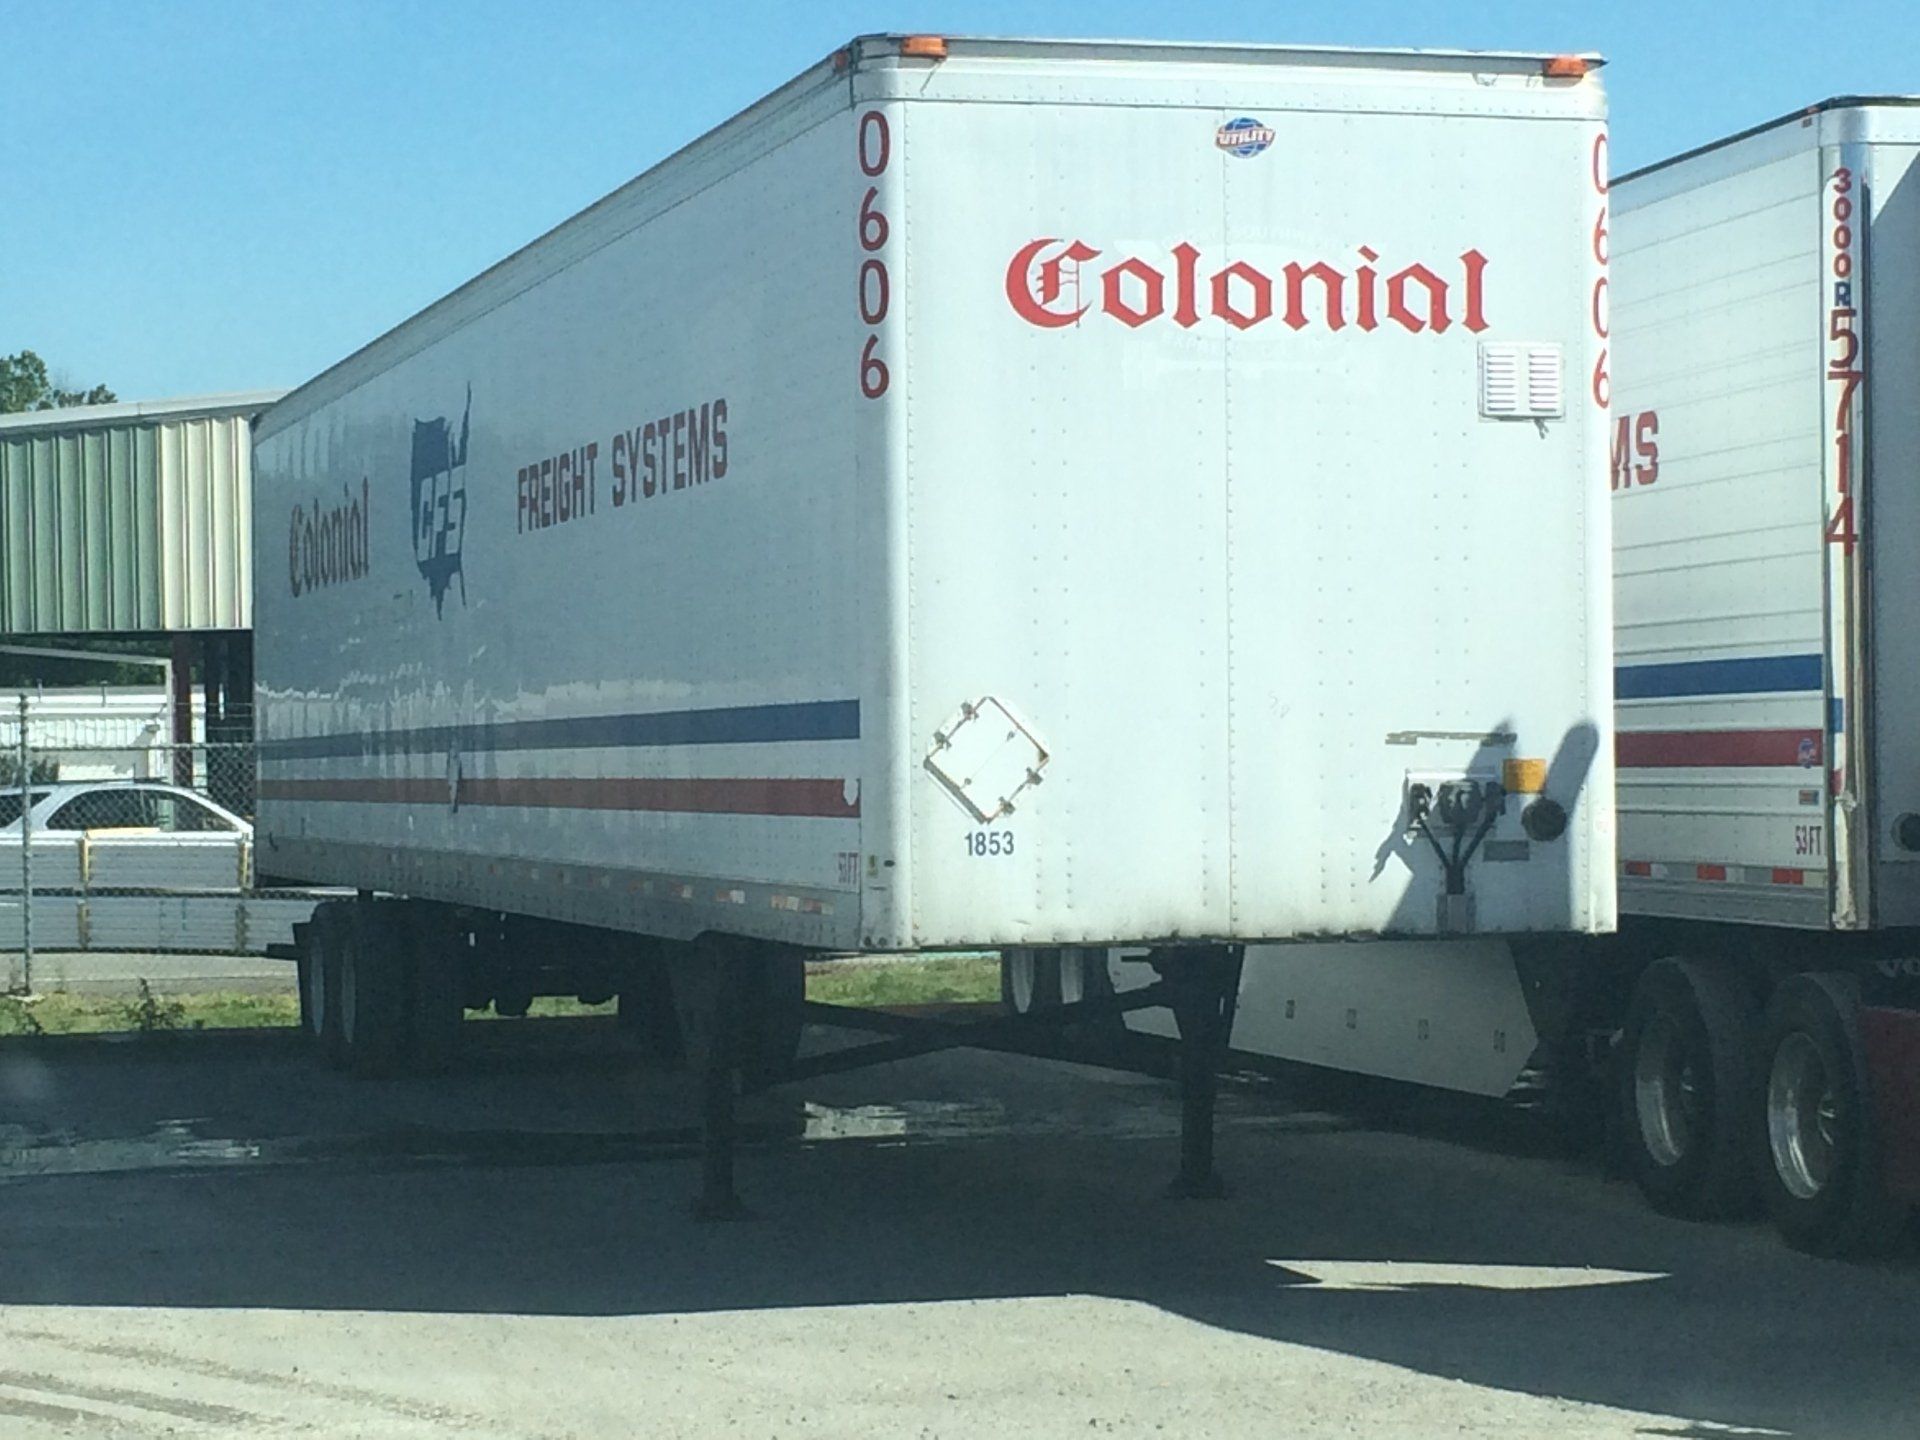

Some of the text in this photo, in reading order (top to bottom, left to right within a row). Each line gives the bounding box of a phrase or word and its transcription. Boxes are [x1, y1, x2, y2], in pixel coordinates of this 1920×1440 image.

[1216, 128, 1276, 146] UTILITY
[1005, 238, 1489, 334] Colonial
[517, 398, 728, 534] FREIGHT SYSTEMS
[289, 476, 370, 598] Colonial
[964, 830, 1015, 856] 1853
